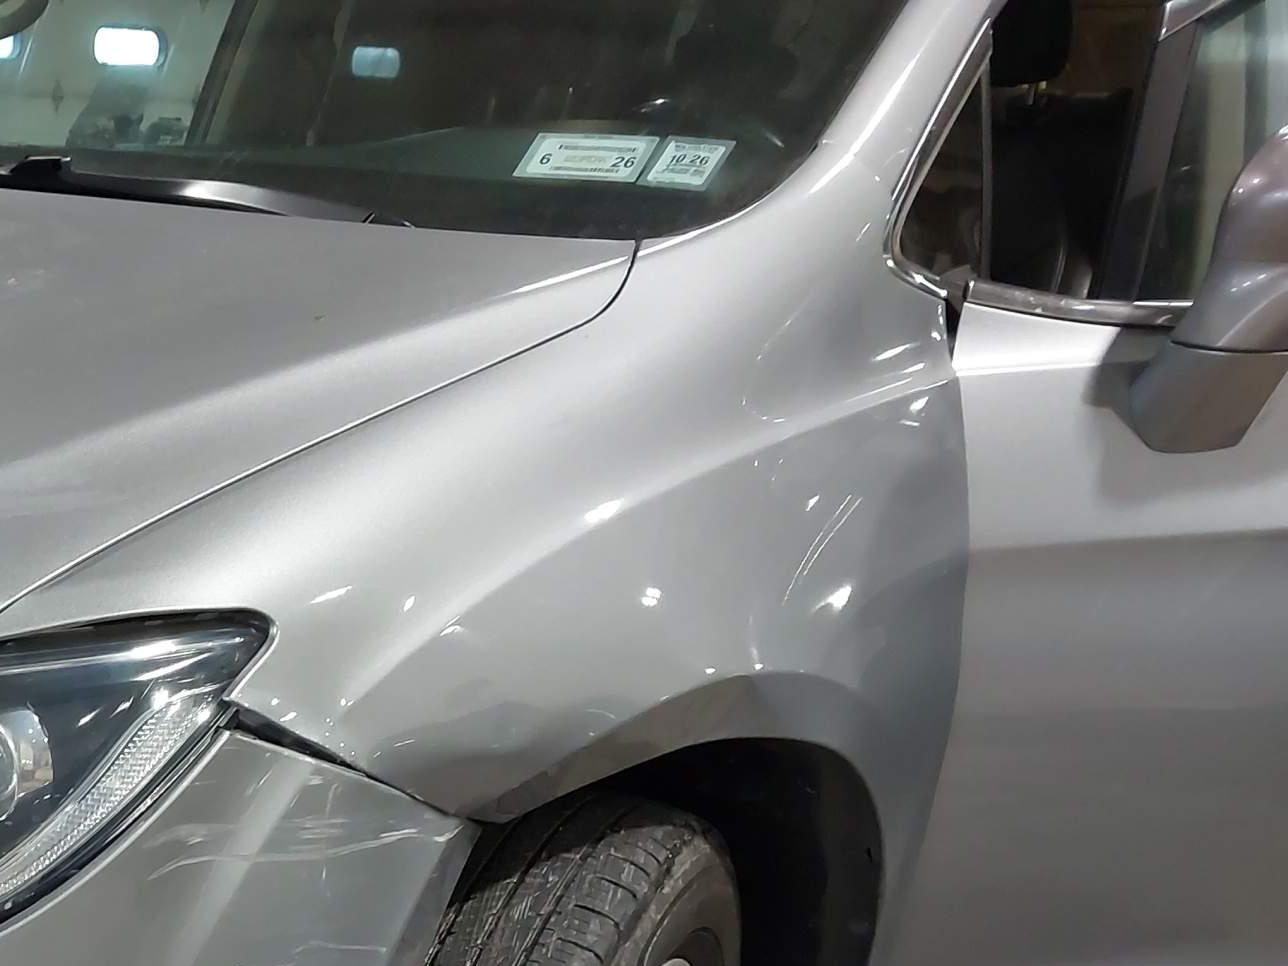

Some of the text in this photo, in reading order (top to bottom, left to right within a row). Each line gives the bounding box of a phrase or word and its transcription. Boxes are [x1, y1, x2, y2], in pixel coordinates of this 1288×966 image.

[539, 153, 552, 165] 6
[610, 156, 637, 169] 26
[689, 154, 711, 166] 26
